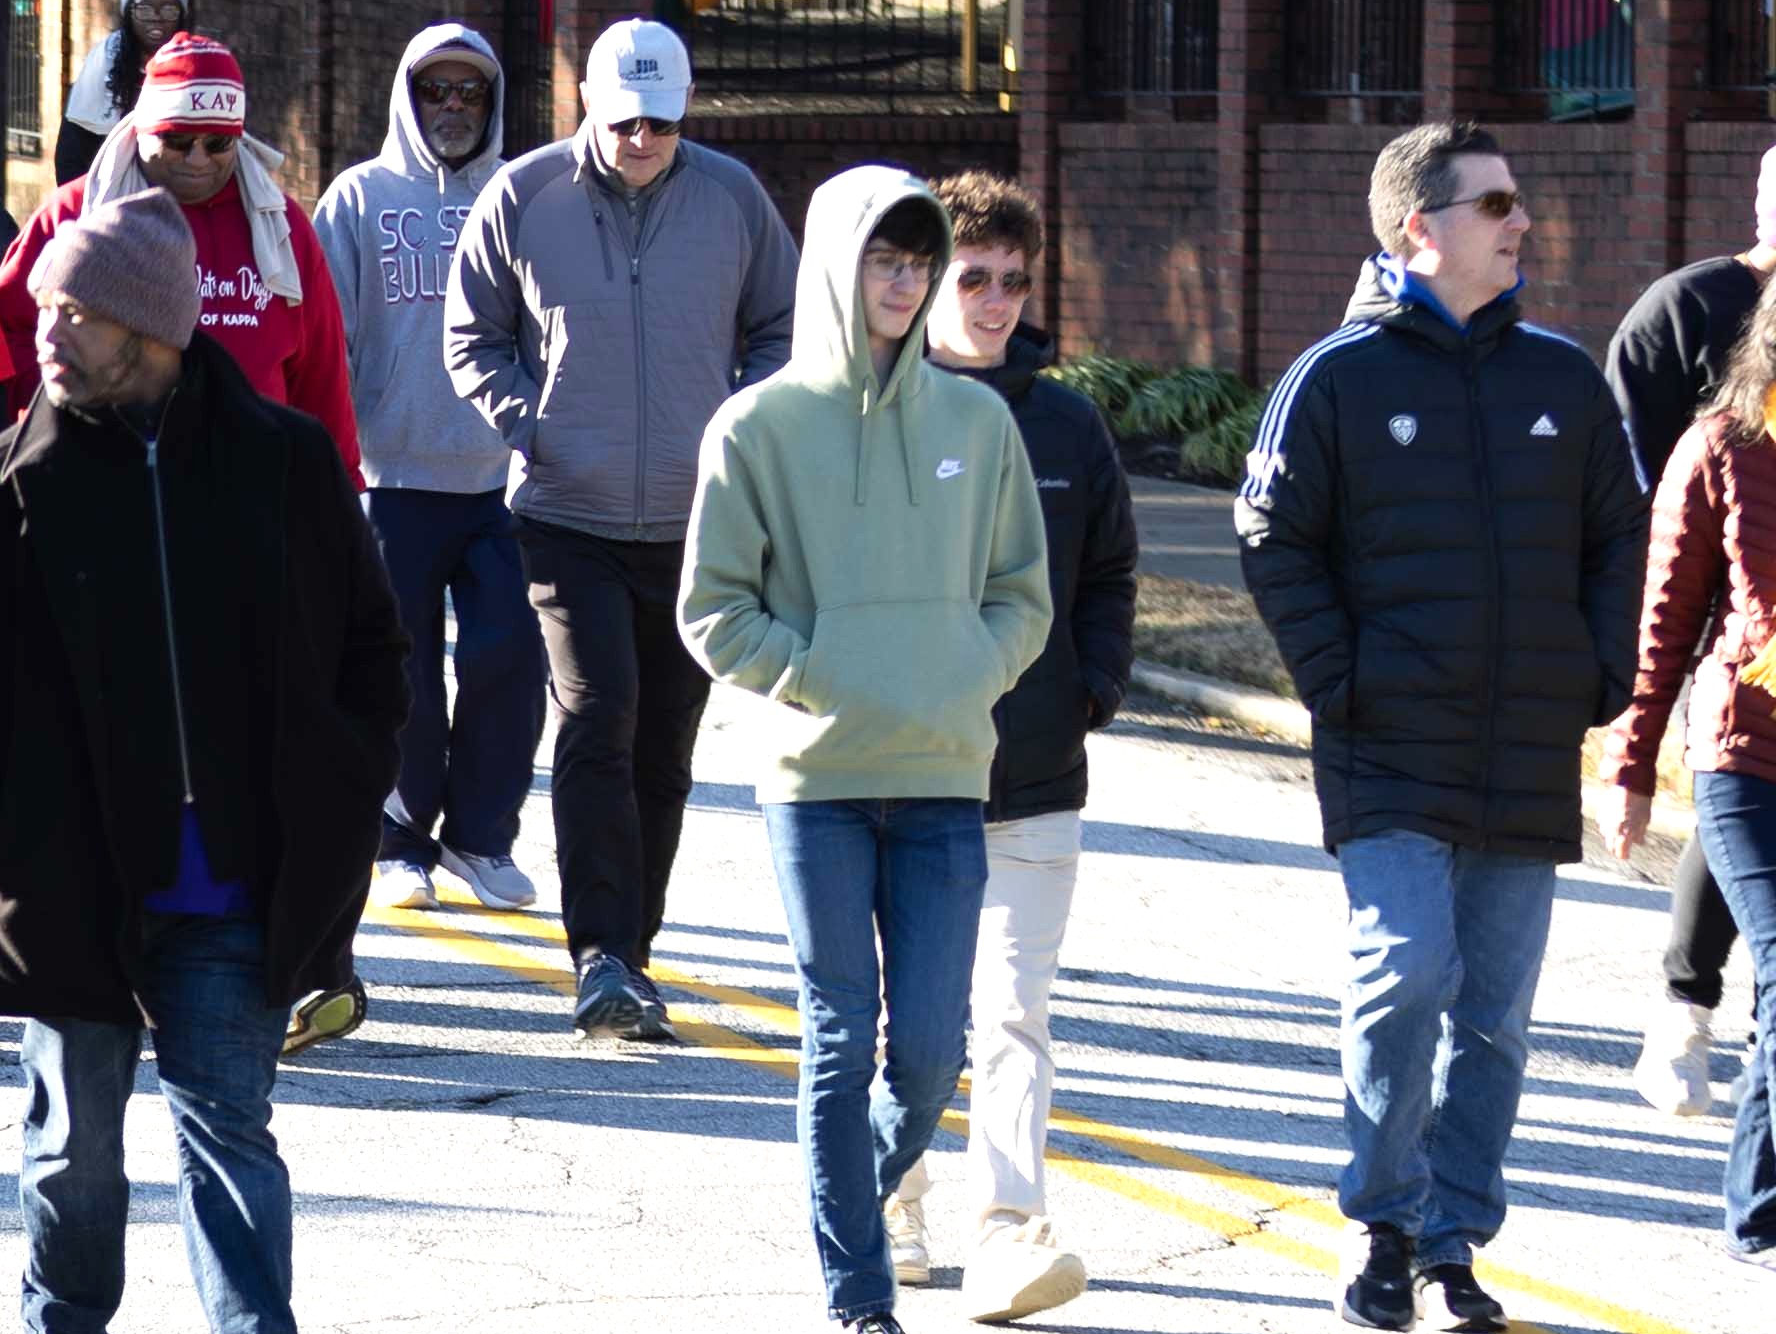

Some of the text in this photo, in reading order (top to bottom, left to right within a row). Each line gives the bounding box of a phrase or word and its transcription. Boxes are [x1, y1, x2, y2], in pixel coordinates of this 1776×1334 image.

[378, 208, 428, 253] SC
[218, 281, 236, 298] on
[379, 254, 454, 304] BULL
[200, 313, 259, 327] OF KAPPA
